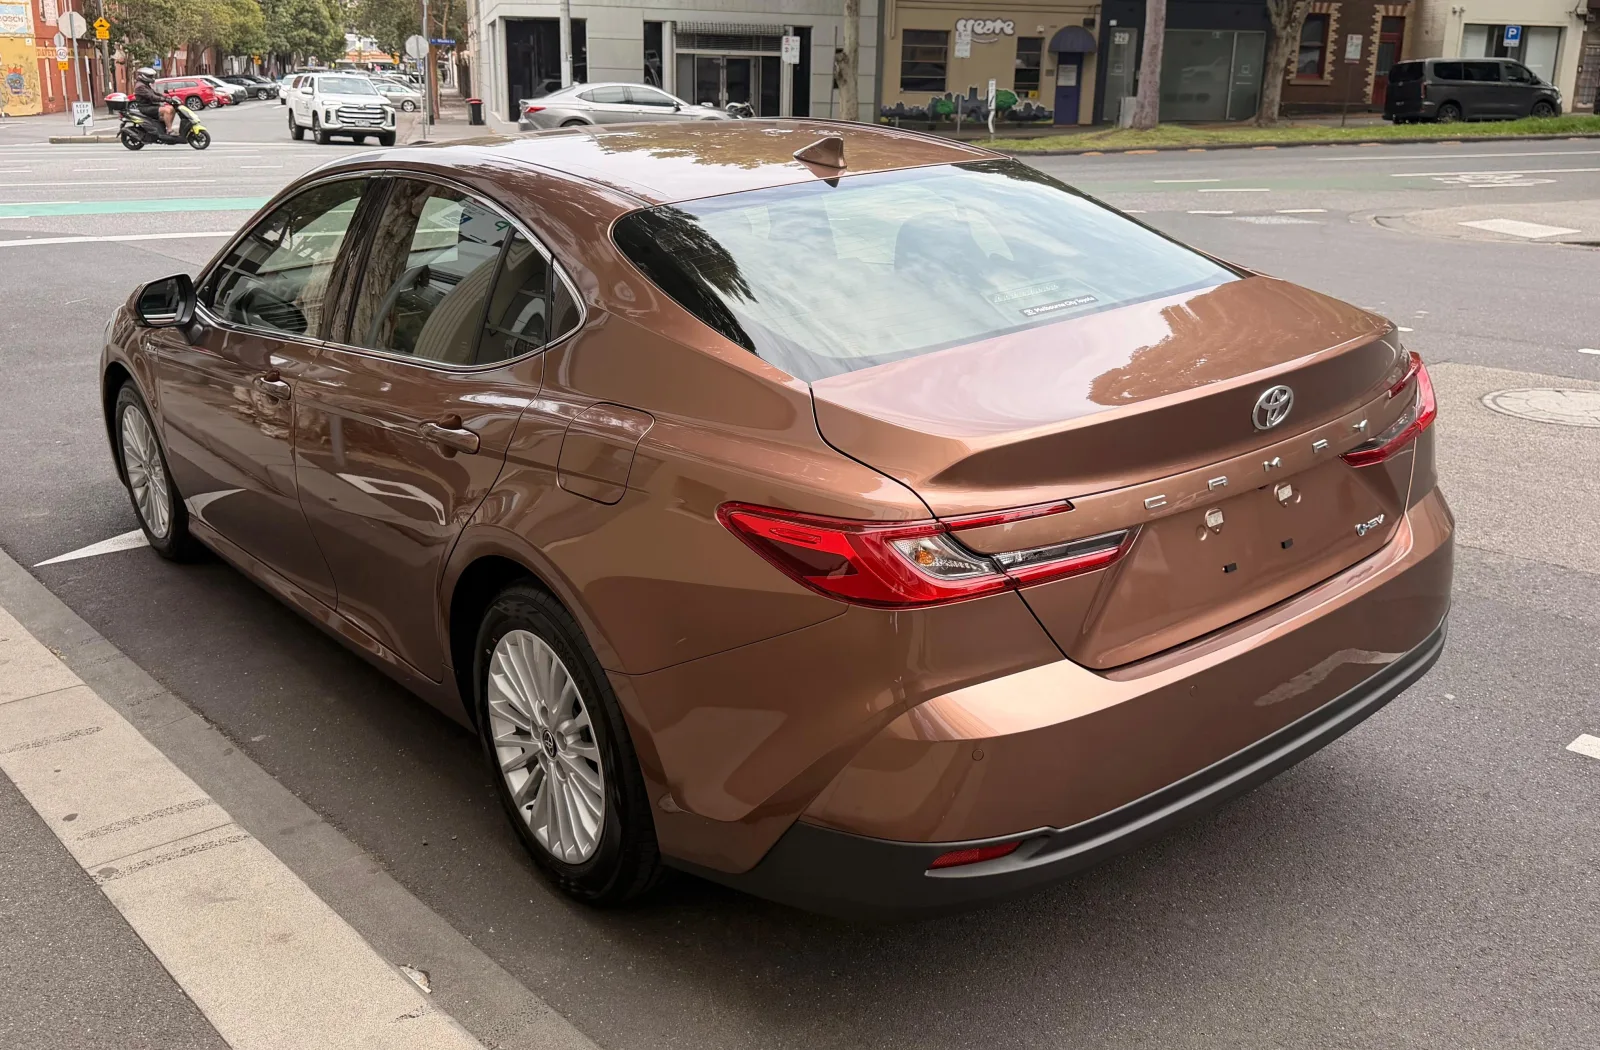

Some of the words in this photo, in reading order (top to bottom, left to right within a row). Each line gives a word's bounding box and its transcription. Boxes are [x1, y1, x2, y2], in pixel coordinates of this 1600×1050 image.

[956, 18, 1016, 35] create
[1508, 28, 1517, 38] P
[1035, 302, 1065, 312] Melbourne
